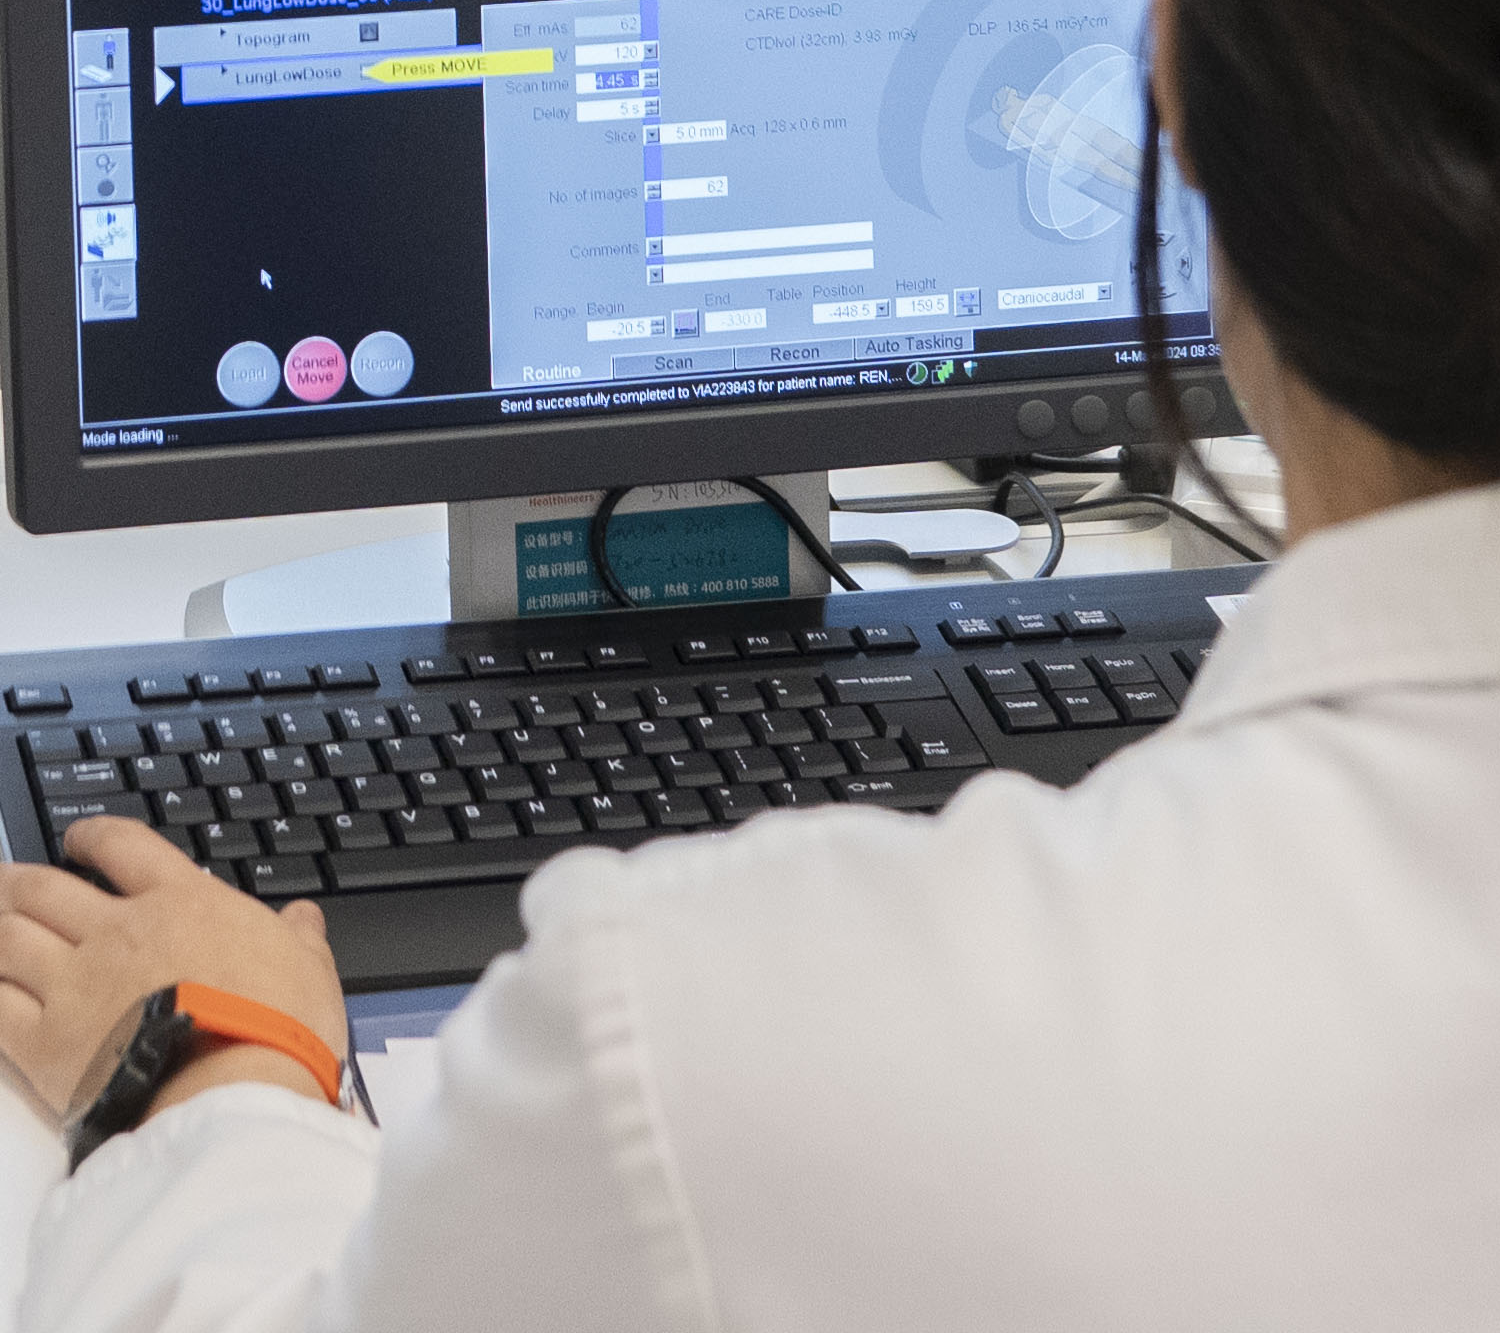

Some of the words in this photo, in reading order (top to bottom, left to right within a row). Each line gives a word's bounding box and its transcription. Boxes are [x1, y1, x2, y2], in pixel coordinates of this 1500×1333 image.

[744, 6, 785, 22] CARE
[537, 21, 569, 36] mAs
[619, 17, 638, 31] 62
[236, 29, 312, 49] Topogram
[887, 27, 919, 44] mGy
[615, 45, 638, 59] 120
[236, 65, 341, 86] LungLowDose
[391, 61, 435, 78] Press
[441, 57, 487, 74] MOVE
[504, 80, 537, 95] Scan
[538, 78, 570, 93] time
[532, 106, 571, 123] Delay
[763, 118, 788, 133] 128
[822, 116, 847, 130] mm
[604, 129, 637, 144] Slice
[699, 125, 724, 139] mm
[588, 186, 639, 203] images
[706, 180, 725, 194] 62
[569, 241, 640, 260] Comments
[767, 286, 803, 302] Table
[812, 281, 864, 299] Position
[895, 276, 937, 294] Height
[703, 292, 731, 307] End
[1001, 287, 1085, 307] Craniocaudal
[533, 304, 577, 321] Range
[586, 301, 625, 318] Begin
[864, 337, 900, 355] Auto
[905, 333, 964, 354] Tasking
[769, 345, 820, 362] Recon
[291, 354, 339, 370] Cancel
[359, 356, 405, 371] Recon
[654, 355, 694, 371] Scan
[296, 370, 334, 385] Move
[522, 363, 582, 383] Routine
[500, 398, 533, 414] Send
[535, 393, 610, 413] successfully
[612, 389, 675, 407] completed
[677, 387, 690, 400] to
[757, 377, 776, 393] for
[777, 375, 817, 394] patient
[819, 373, 857, 389] name:
[81, 429, 116, 448] Mode
[118, 427, 164, 448] loading
[528, 493, 596, 508] Healthineers
[700, 579, 724, 594] 400
[725, 577, 748, 592] 810
[750, 575, 779, 590] 5888
[806, 631, 828, 641] F11
[866, 627, 889, 637] F12
[746, 636, 770, 646] F10
[1044, 662, 1076, 672] Home
[1104, 658, 1135, 669] PgUp
[859, 674, 912, 685] Backspace
[985, 667, 1017, 677] Insert
[1066, 695, 1090, 705] End
[1126, 690, 1158, 701] PgDn
[1005, 699, 1038, 709] Delete
[922, 746, 950, 756] Enter
